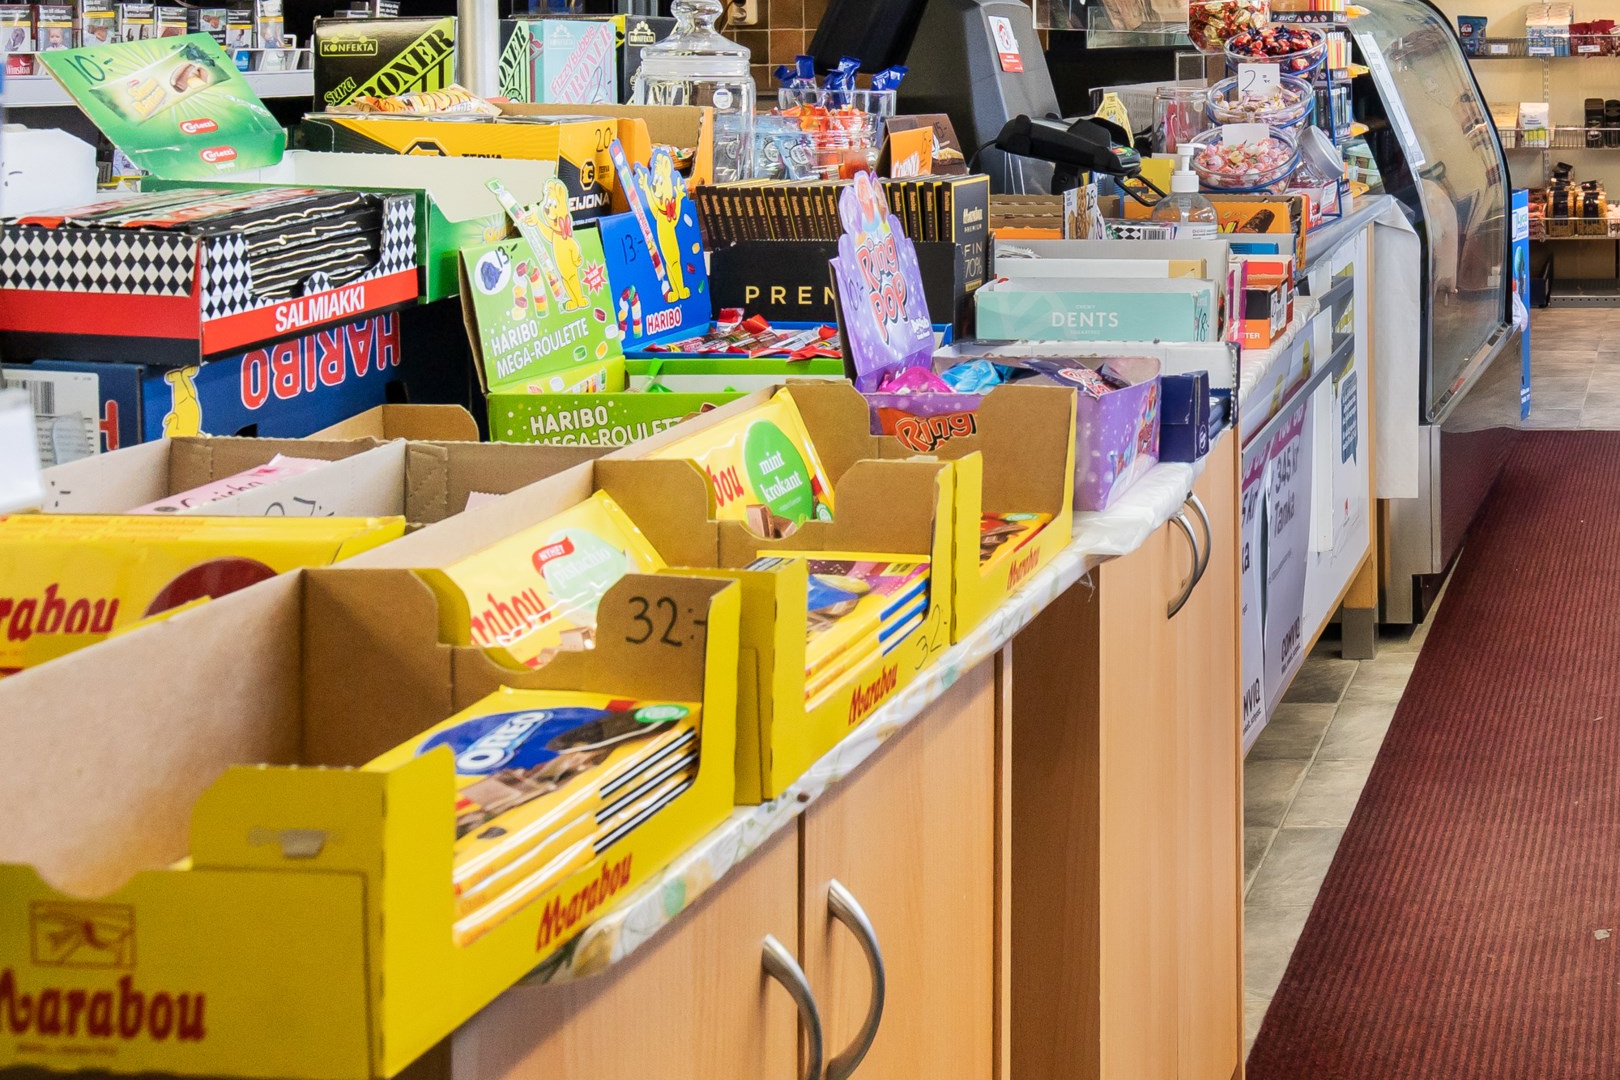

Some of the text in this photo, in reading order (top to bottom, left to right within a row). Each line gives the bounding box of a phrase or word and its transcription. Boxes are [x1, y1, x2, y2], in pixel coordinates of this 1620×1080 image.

[323, 43, 375, 54] KONFEKTA
[356, 27, 455, 107] RONER
[323, 76, 357, 107] Sura
[568, 193, 610, 211] EIJONA
[856, 232, 898, 291] Ring
[963, 241, 983, 258] FIN
[964, 258, 984, 279] 70%
[275, 286, 365, 333] SALMIAKKI
[646, 307, 682, 336] HARIBO
[1051, 312, 1119, 328] DENTS
[490, 319, 540, 358] HARIBO
[496, 317, 590, 380] MEGA-ROULETTE
[240, 311, 401, 410] HARIBO
[530, 405, 609, 436] HARIBO
[896, 412, 978, 452] Ring
[758, 450, 786, 476] mint
[759, 470, 803, 504] krokant
[539, 544, 566, 559] NYHET
[0, 583, 120, 643] rabou
[472, 587, 552, 647] rabou
[625, 596, 707, 647] 32:-
[847, 661, 898, 727] Marabou
[1243, 677, 1261, 719] MVIQ
[456, 710, 546, 772] OREO
[535, 854, 633, 952] Marabou
